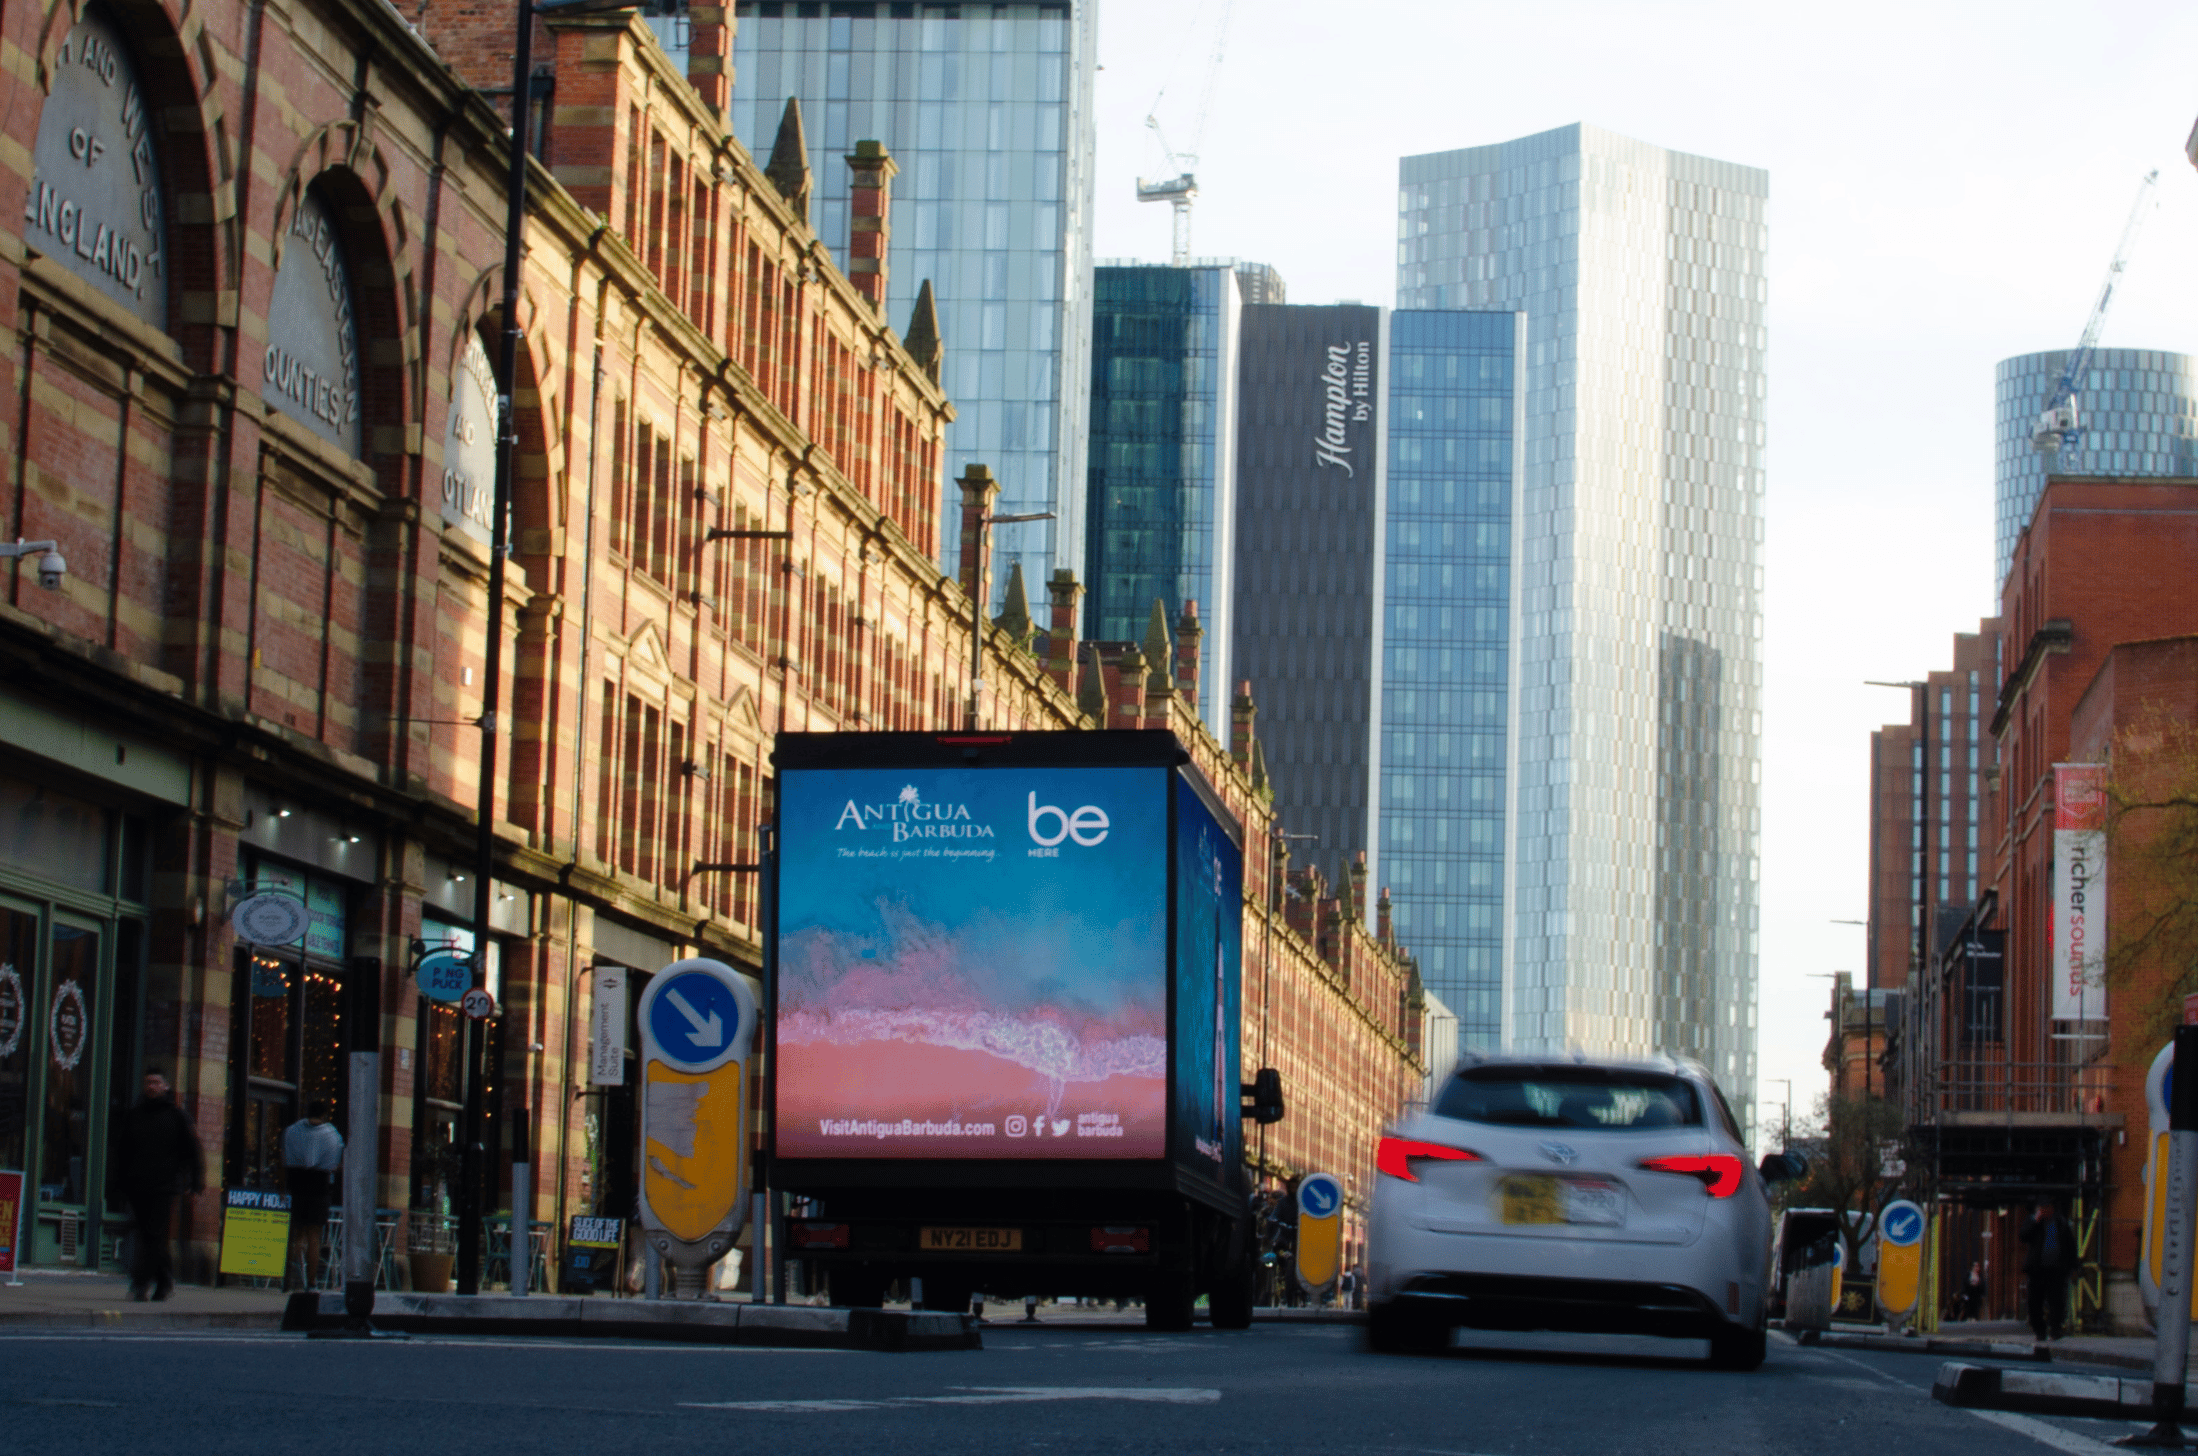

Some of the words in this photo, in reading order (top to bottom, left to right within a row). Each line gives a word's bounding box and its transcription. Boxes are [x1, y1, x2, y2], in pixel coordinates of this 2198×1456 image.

[69, 126, 104, 169] OF
[80, 34, 117, 87] AND
[122, 82, 162, 278] WEST
[1352, 341, 1370, 397] Hilton
[263, 343, 343, 435] OUNTIES,
[1314, 340, 1354, 478] Hampton
[1352, 400, 1373, 422] by
[834, 799, 972, 831] ANTIGUA
[1028, 790, 1110, 847] be
[892, 821, 995, 843] BARBUDA
[837, 847, 855, 858] The
[858, 847, 888, 858] beach
[890, 849, 899, 858] is
[900, 848, 921, 862] just
[923, 847, 940, 858] the
[1028, 848, 1060, 858] HERE
[433, 979, 462, 990] PUCK
[465, 997, 489, 1010] 20
[598, 1003, 611, 1076] Management
[608, 1047, 619, 1077] Suite
[820, 1119, 995, 1139] VisitAntiguaBarbuda.com
[1077, 1113, 1119, 1125] antigua
[1077, 1124, 1123, 1137] barbuda
[228, 1190, 261, 1206] HAPPY
[930, 1230, 972, 1247] NY21
[976, 1230, 1011, 1247] EDJ
